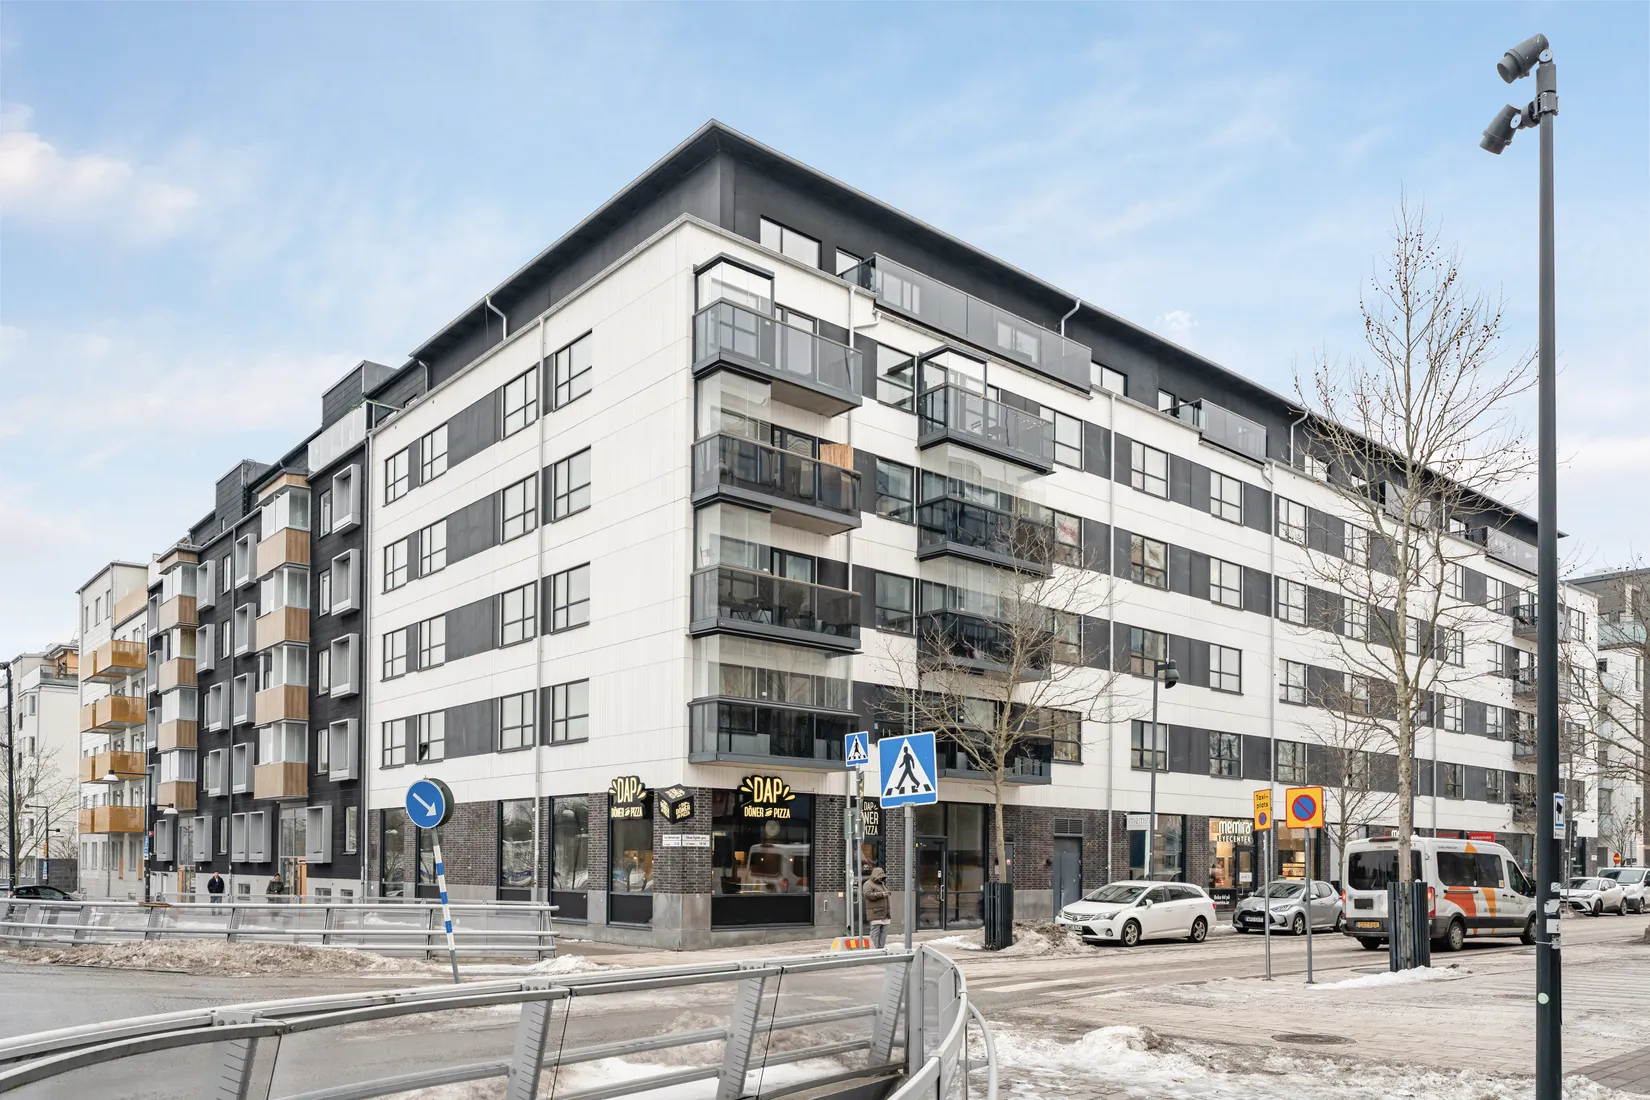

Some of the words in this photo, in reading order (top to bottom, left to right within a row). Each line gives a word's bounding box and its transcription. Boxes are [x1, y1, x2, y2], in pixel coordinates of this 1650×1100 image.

[617, 777, 637, 803] DAP
[754, 776, 783, 803] DAP
[611, 806, 624, 818] DÖNER
[630, 806, 643, 817] PIZZA
[744, 805, 764, 818] DÖNER
[773, 807, 791, 819] PIZZA
[864, 801, 874, 811] DAP
[863, 811, 879, 825] NER
[865, 825, 879, 836] IZZA
[1219, 821, 1251, 834] memira
